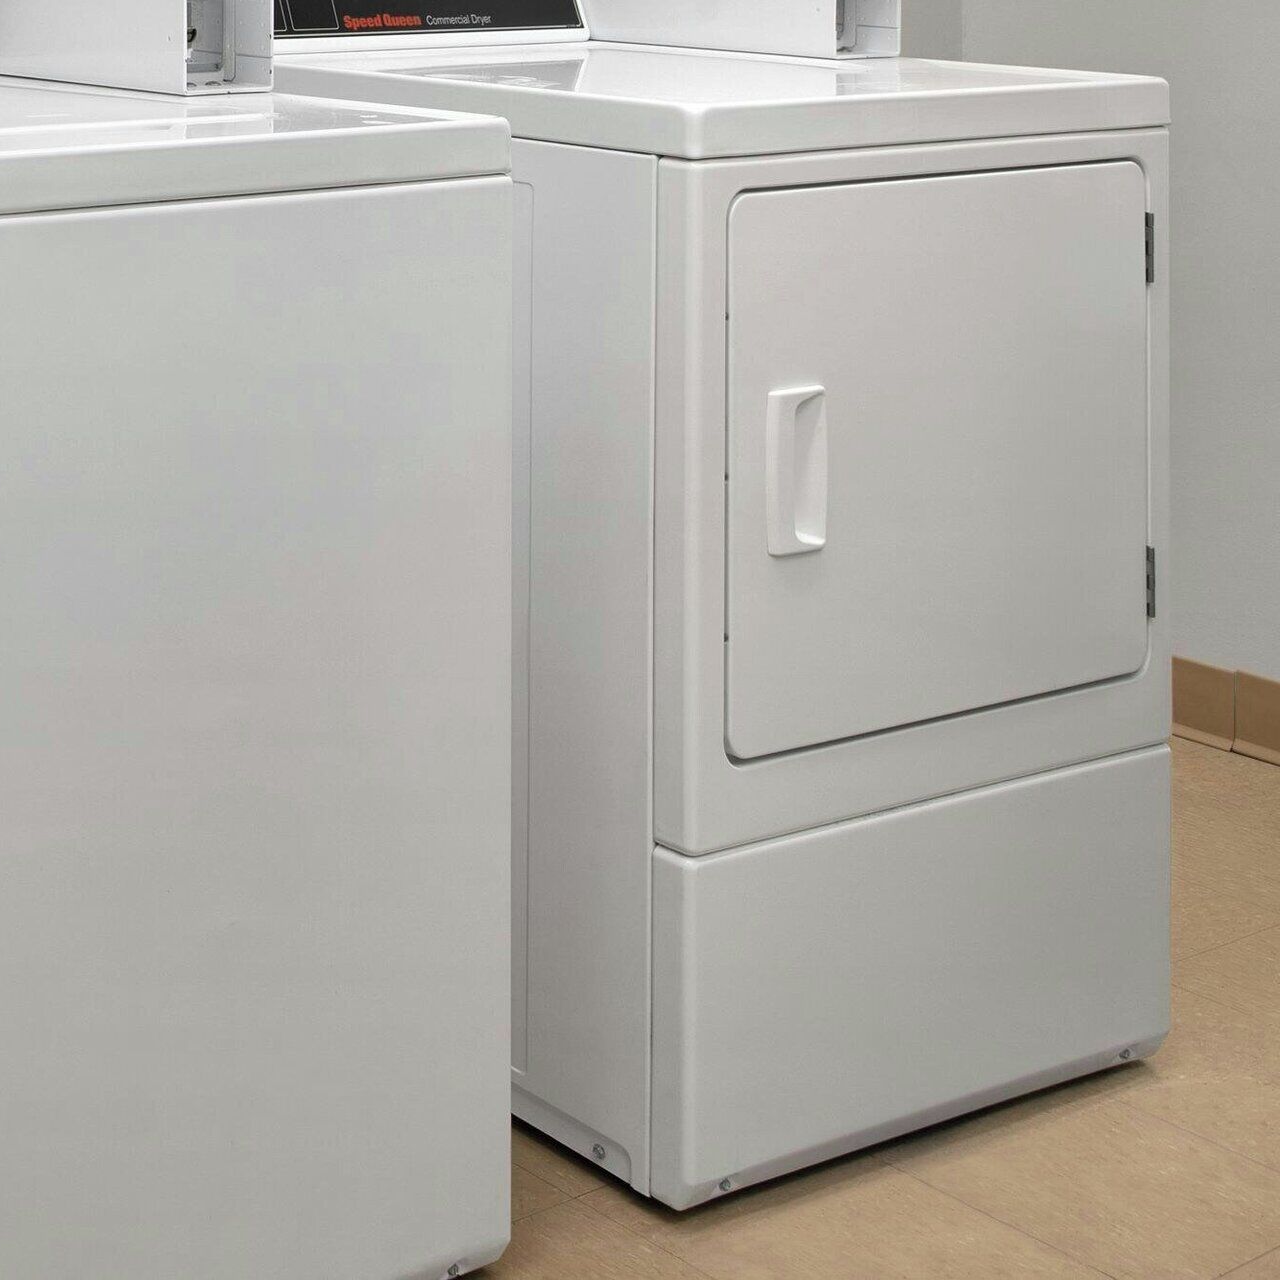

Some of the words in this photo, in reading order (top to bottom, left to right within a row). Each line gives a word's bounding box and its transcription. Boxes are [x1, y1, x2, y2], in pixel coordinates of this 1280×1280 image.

[343, 13, 382, 30] Speed
[382, 12, 422, 27] Queen
[425, 14, 470, 26] Commercial
[470, 14, 491, 26] Dryer
